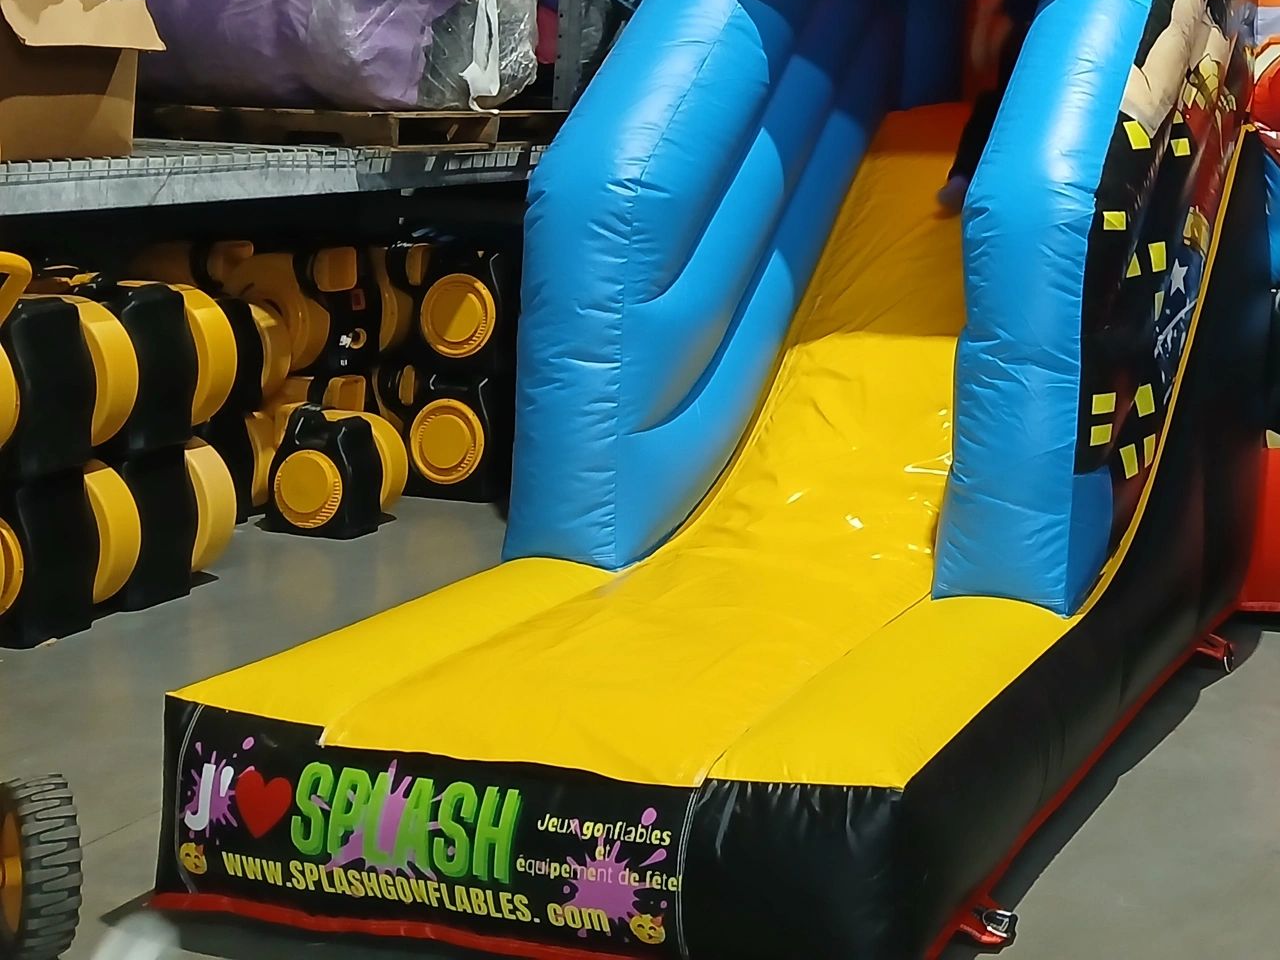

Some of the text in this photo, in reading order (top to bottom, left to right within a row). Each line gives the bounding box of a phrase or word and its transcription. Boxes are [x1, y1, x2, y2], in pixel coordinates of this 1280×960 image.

[290, 761, 522, 885] SPLASH
[537, 813, 673, 846] Jeux gonflables
[595, 843, 611, 861] et
[516, 854, 613, 883] équipement
[618, 867, 640, 887] de
